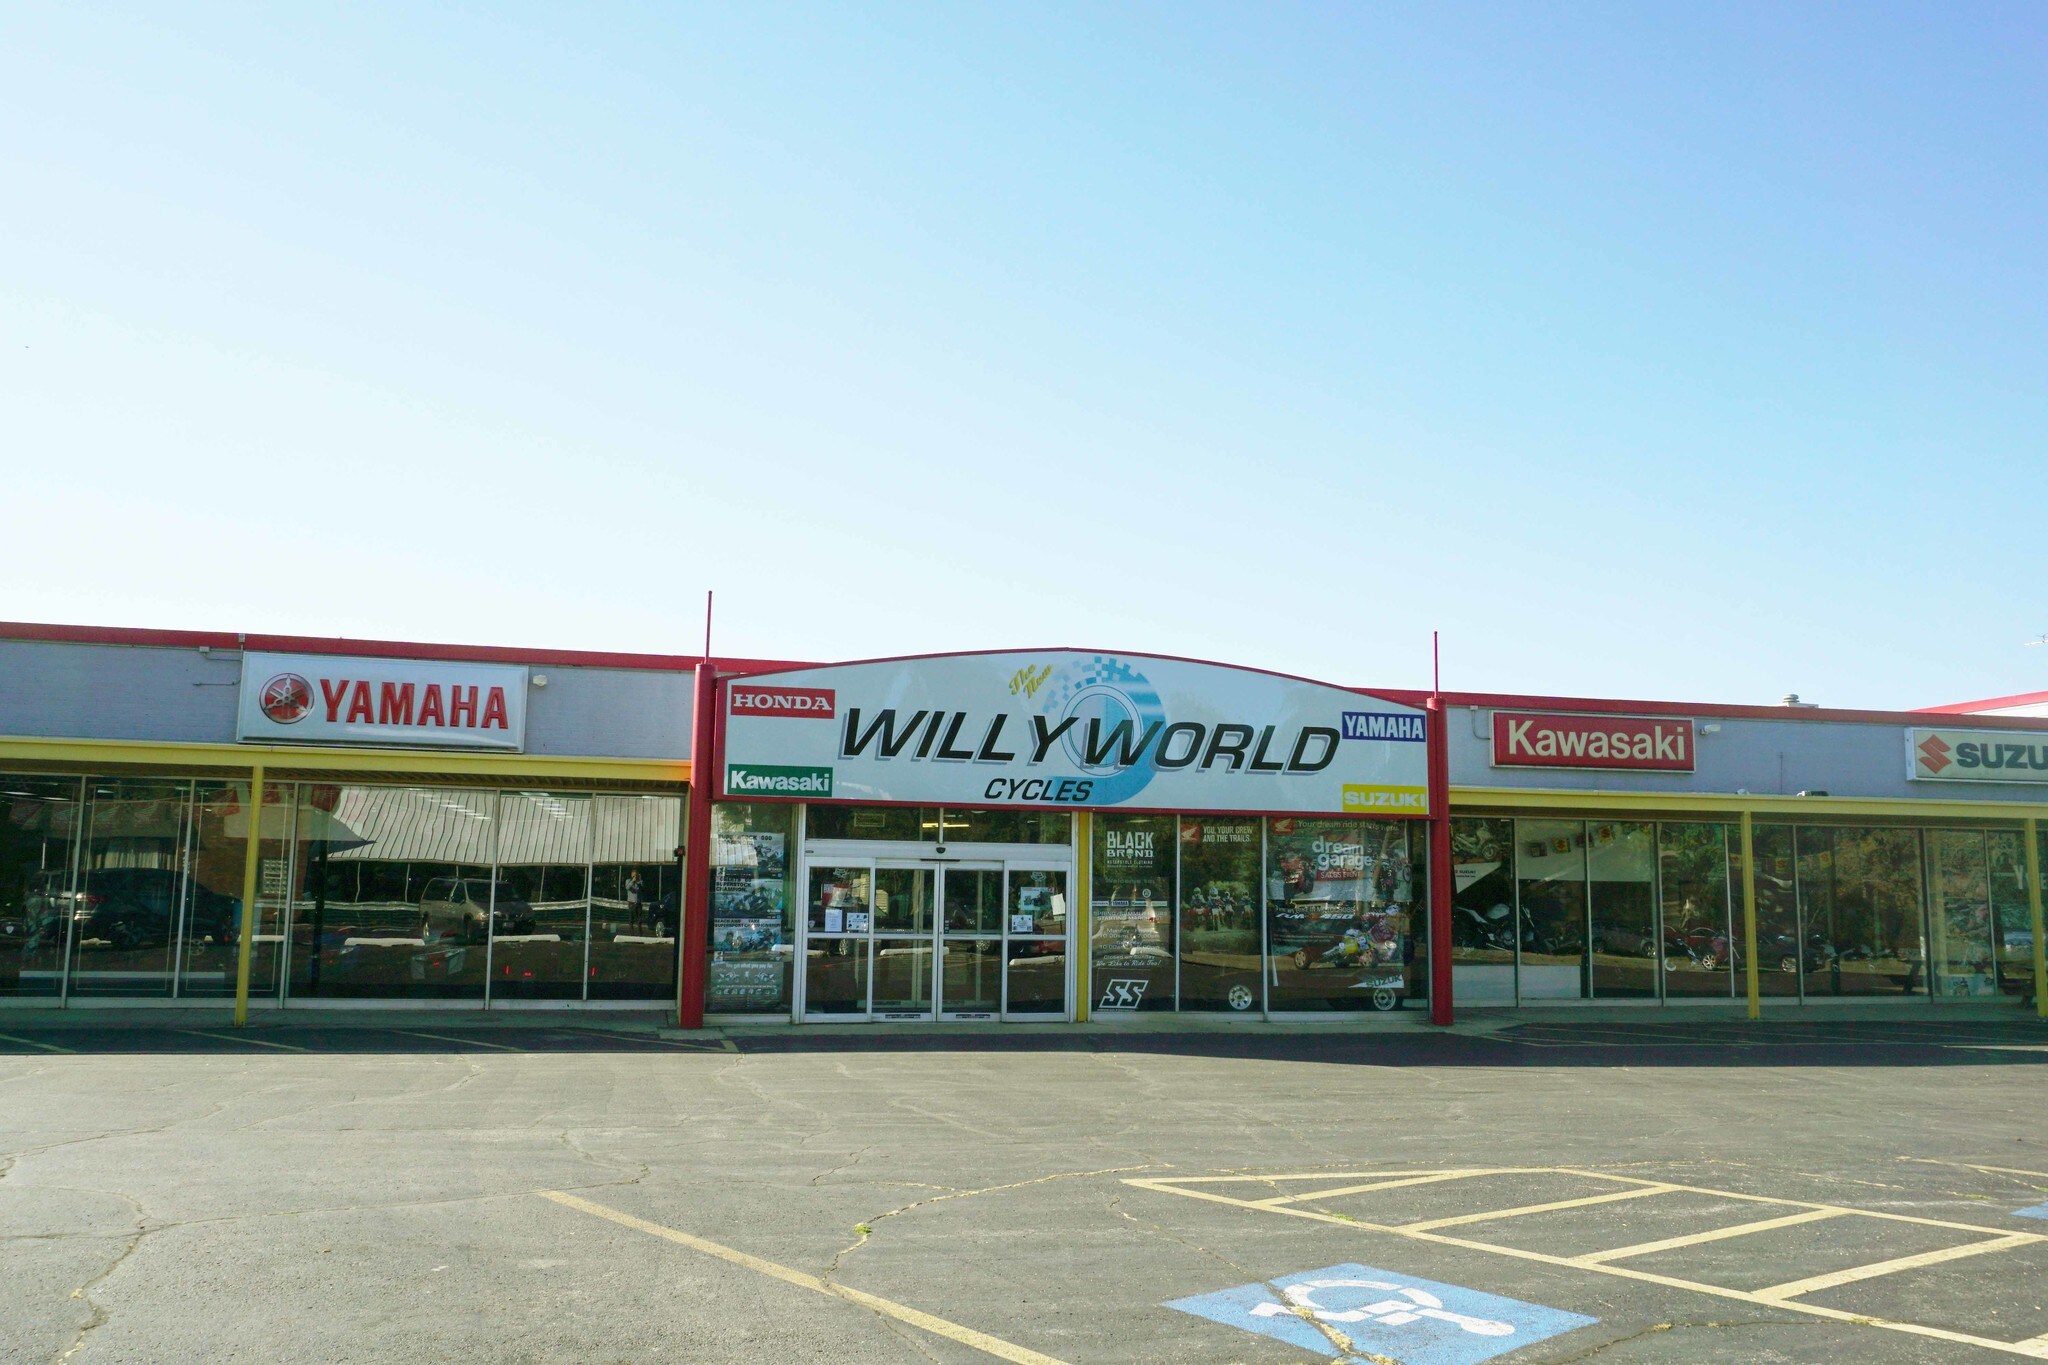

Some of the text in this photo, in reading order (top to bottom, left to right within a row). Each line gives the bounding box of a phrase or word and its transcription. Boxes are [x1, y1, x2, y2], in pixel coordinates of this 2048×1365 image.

[1009, 664, 1036, 695] The
[1023, 664, 1052, 698] New
[320, 679, 509, 729] YAMAHA
[733, 693, 832, 711] HONDA
[1344, 715, 1424, 739] YAMAHA
[1508, 719, 1685, 761] Kawasaki
[731, 770, 829, 791] Kawasaki
[984, 777, 1094, 802] CYCLES
[1343, 791, 1426, 807] SUZUKI
[1203, 834, 1215, 842] AND
[1217, 834, 1228, 842] THE
[1217, 825, 1234, 834] YOUR
[1235, 825, 1253, 834] CREW
[1107, 831, 1154, 849] BLACK
[1312, 836, 1364, 854] dream
[1107, 848, 1154, 859] BRND
[1317, 853, 1373, 871] garage
